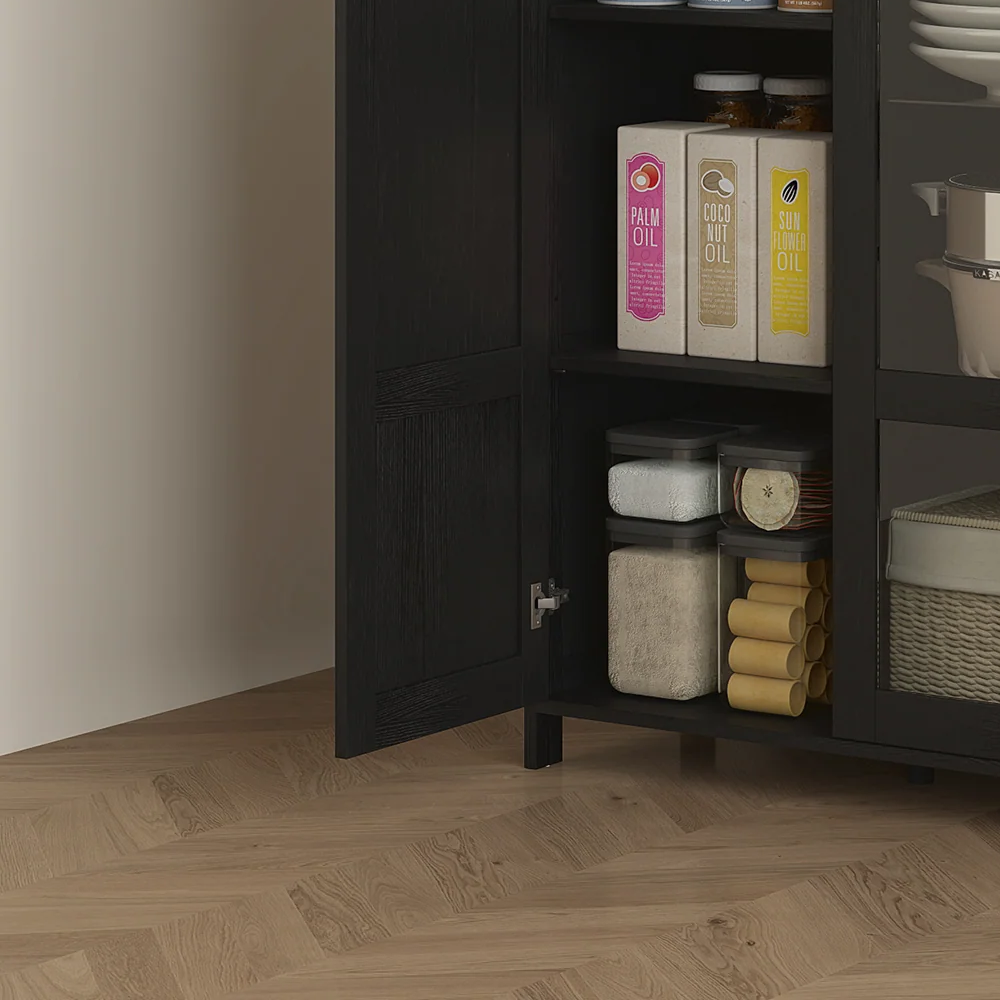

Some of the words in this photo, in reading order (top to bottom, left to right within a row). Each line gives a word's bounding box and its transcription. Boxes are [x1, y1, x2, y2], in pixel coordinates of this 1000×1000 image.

[631, 206, 660, 227] PALM
[703, 202, 731, 223] COCO
[779, 211, 801, 230] SUN
[633, 226, 658, 247] OIL
[707, 223, 728, 243] NUT
[773, 230, 806, 252] FLOWER
[705, 243, 730, 264] OIL
[777, 251, 803, 272] OIL
